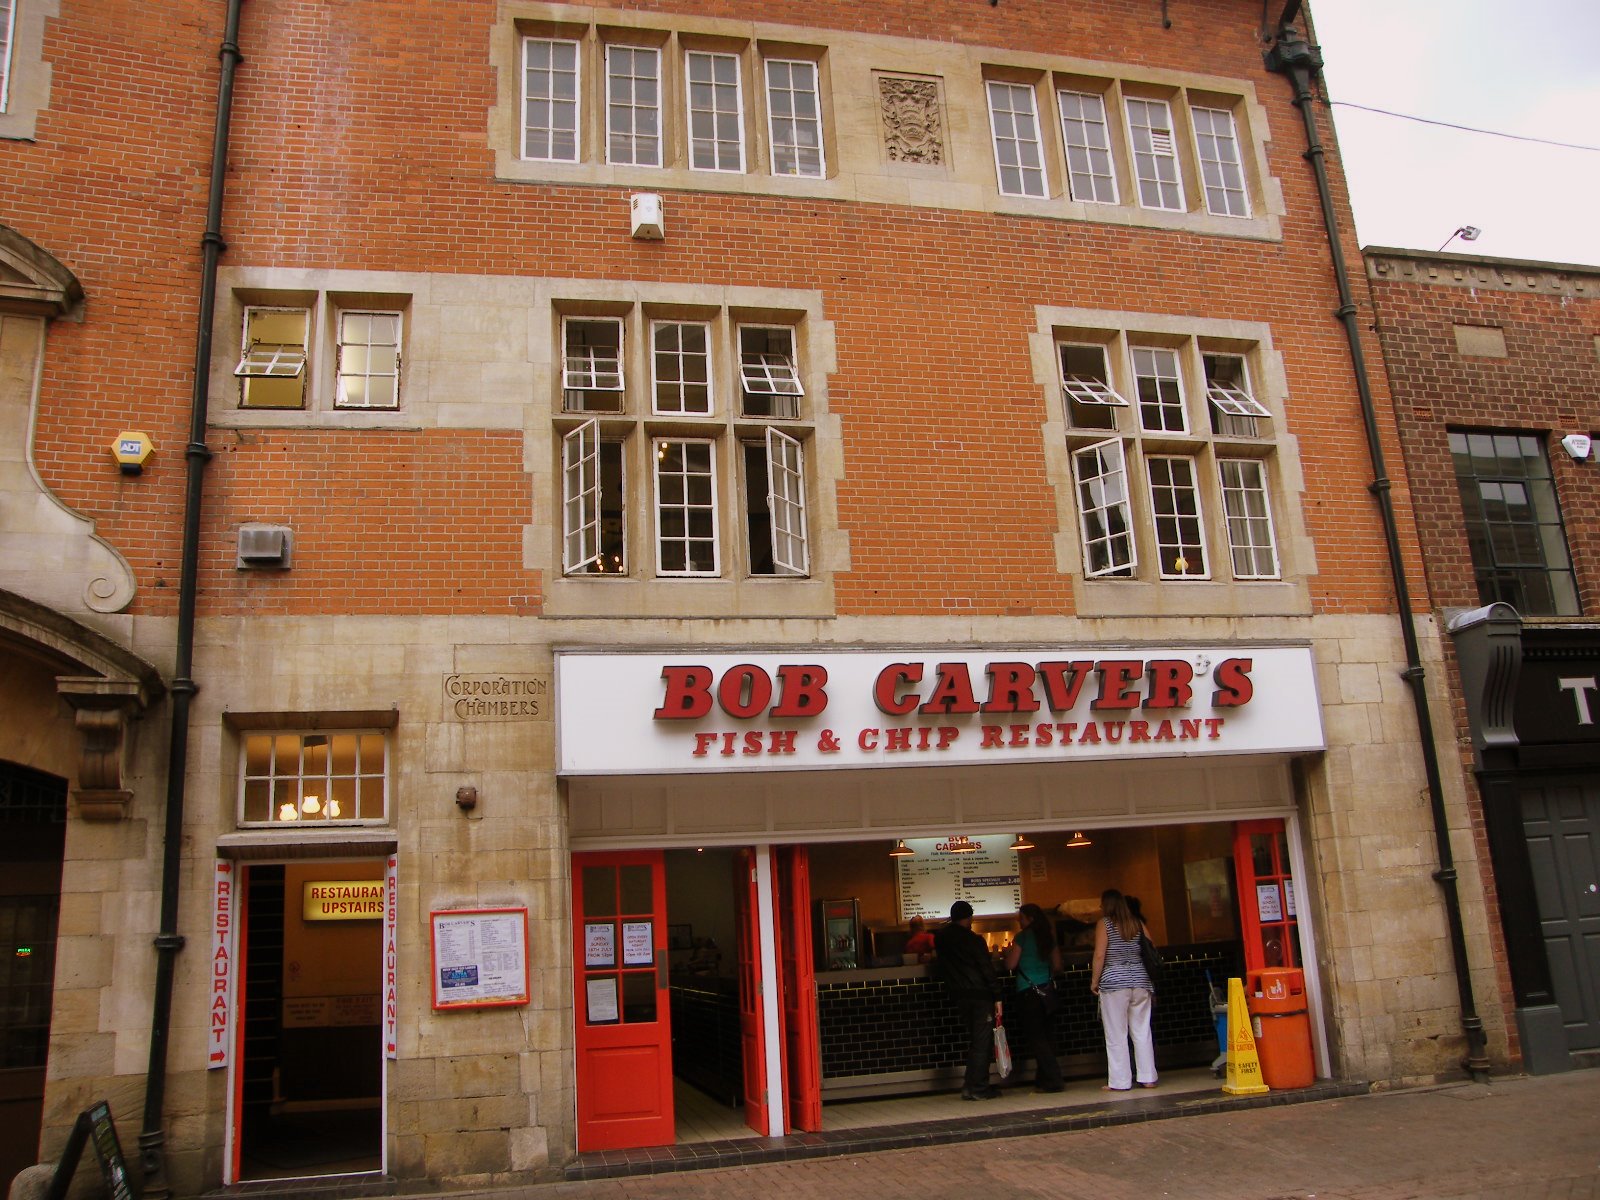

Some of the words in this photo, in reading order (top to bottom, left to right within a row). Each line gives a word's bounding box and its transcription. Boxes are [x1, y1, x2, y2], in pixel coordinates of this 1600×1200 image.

[120, 443, 139, 452] ADT
[445, 674, 547, 700] CORPORATION
[652, 664, 828, 720] BOB
[872, 655, 1253, 716] CARVER'S
[454, 697, 539, 720] CHAMBERS
[692, 731, 798, 755] FISH
[817, 729, 841, 753] &
[858, 726, 960, 751] CHIP
[980, 718, 1225, 747] RESTAURANT
[311, 886, 384, 898] RESTAURAN
[322, 902, 384, 914] UPSTAIRS
[212, 880, 230, 1044] RESTAURANT
[388, 876, 396, 1034] RESTAURANT
